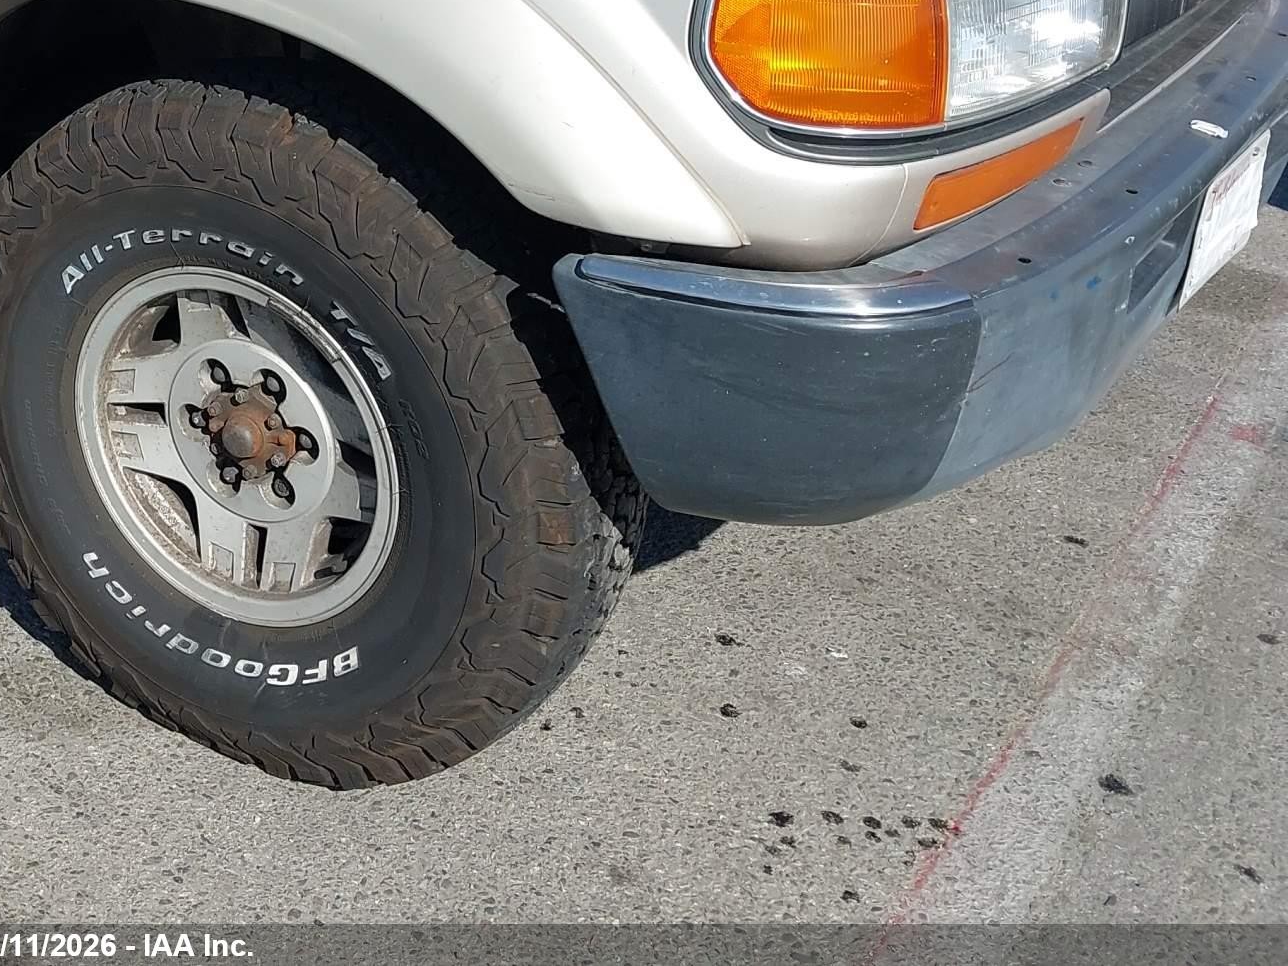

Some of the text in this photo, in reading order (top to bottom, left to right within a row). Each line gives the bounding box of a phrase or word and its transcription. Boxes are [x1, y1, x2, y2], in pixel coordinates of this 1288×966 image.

[61, 228, 304, 294] All-Terrain
[328, 299, 393, 381] T/A
[82, 551, 360, 687] BFGoodrich
